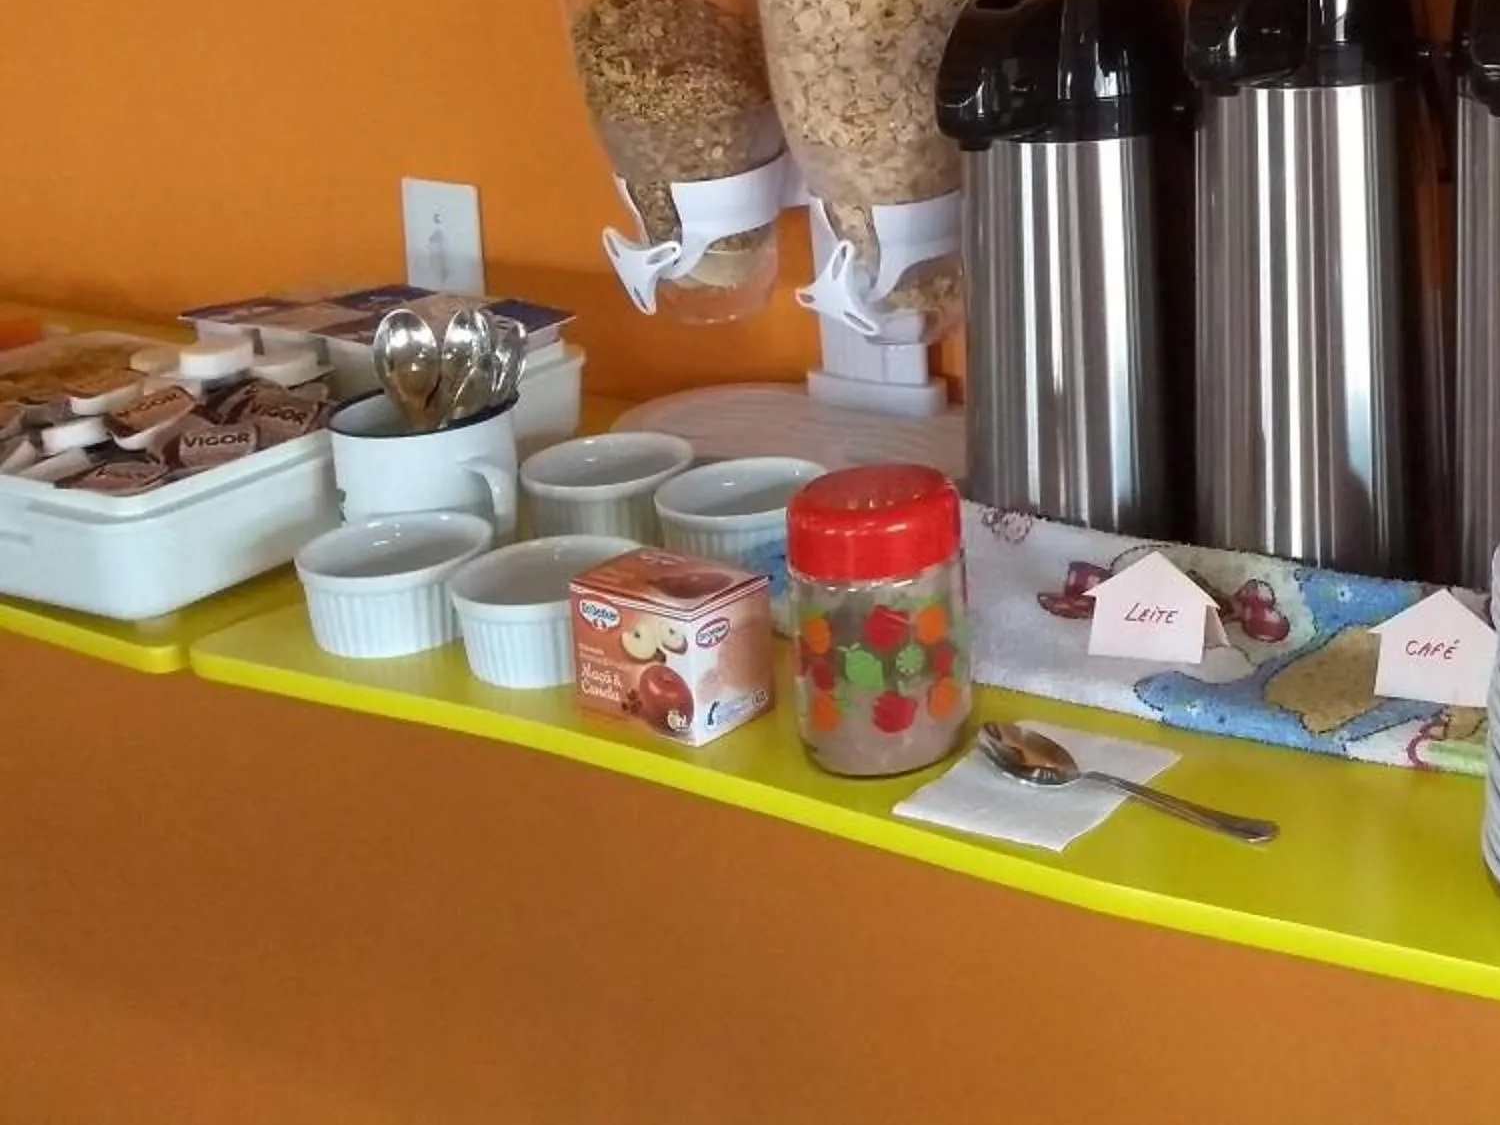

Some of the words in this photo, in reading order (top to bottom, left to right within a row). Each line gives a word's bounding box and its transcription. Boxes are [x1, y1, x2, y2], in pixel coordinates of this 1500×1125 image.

[250, 401, 308, 425] VIGOR
[182, 432, 250, 448] VIGOR
[1405, 638, 1459, 660] CAFÉ
